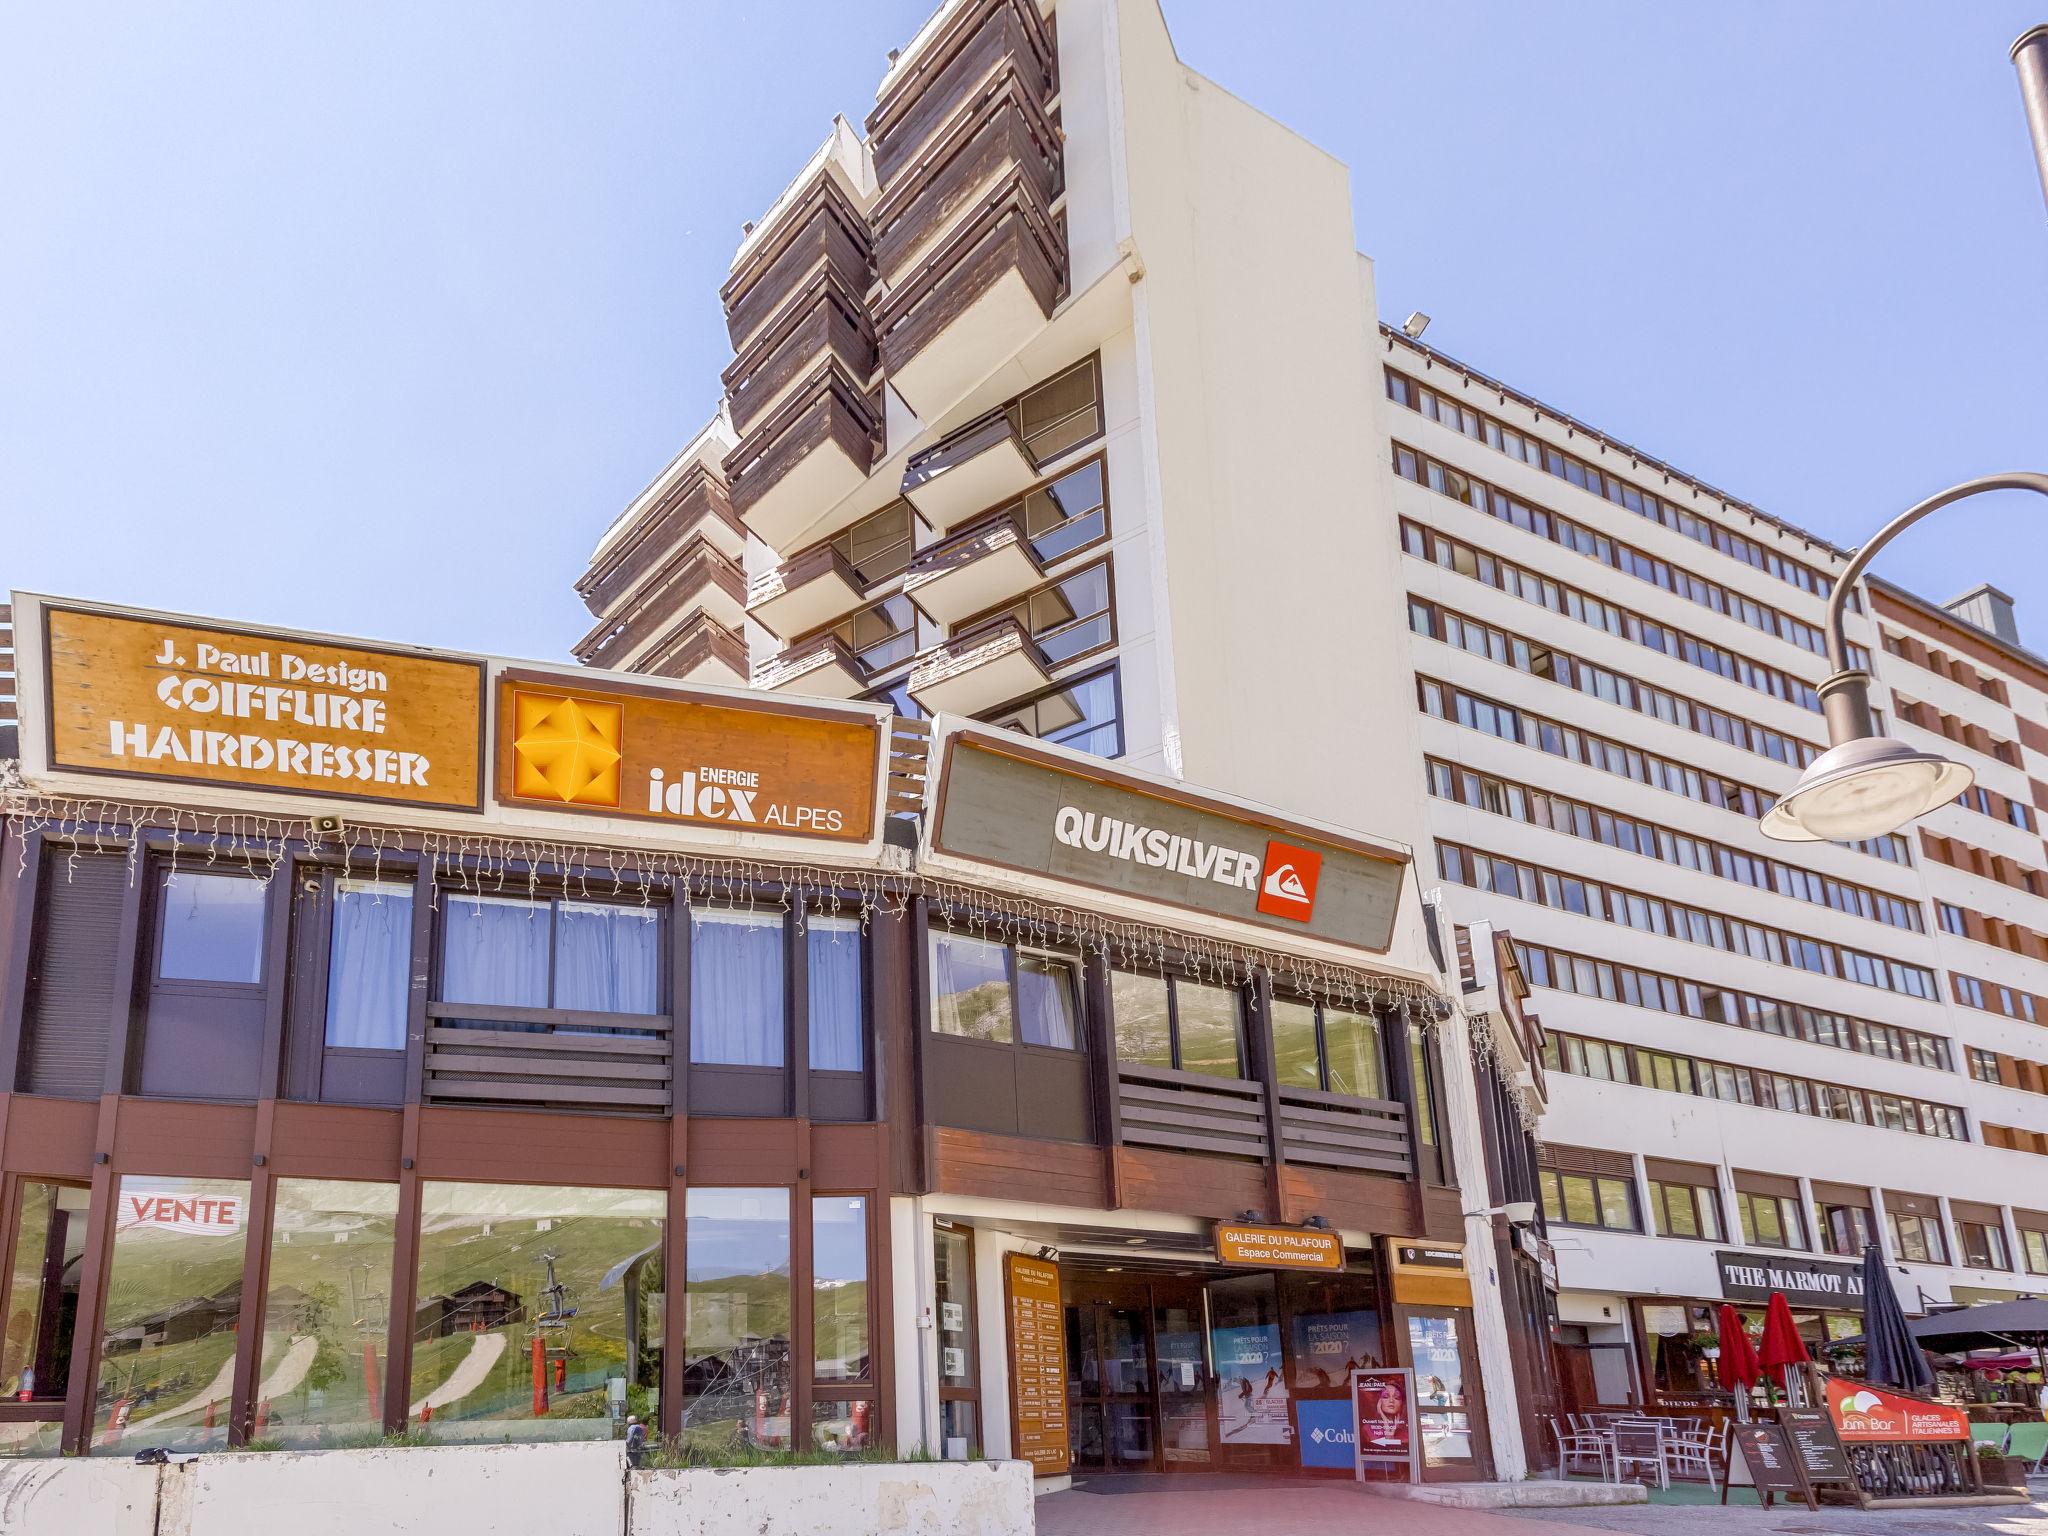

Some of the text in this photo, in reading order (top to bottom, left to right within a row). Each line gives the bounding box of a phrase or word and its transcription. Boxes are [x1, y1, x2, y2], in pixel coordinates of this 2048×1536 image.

[155, 640, 388, 693] J. Paul Design
[157, 675, 386, 734] COIFFURE
[109, 720, 431, 786] HAIRDRESSER
[700, 766, 760, 788] ENERGIE
[648, 767, 758, 823] idex
[763, 803, 843, 832] ALPES
[1054, 806, 1261, 891] QUIKSILVER
[130, 1197, 236, 1225] VENTE
[1225, 1232, 1332, 1249] GALERIE DU PALAFOUR
[1237, 1246, 1324, 1262] Espace Commercial
[1724, 1264, 1766, 1288] THE
[1766, 1268, 1842, 1294] MARMOT
[1431, 1348, 1456, 1361] 2020
[1839, 1417, 1866, 1431] Jam
[1870, 1417, 1896, 1431] Bar
[1911, 1420, 1960, 1429] ARTISANALES
[1912, 1414, 1941, 1422] GLACES
[1324, 1428, 1354, 1443] Colu
